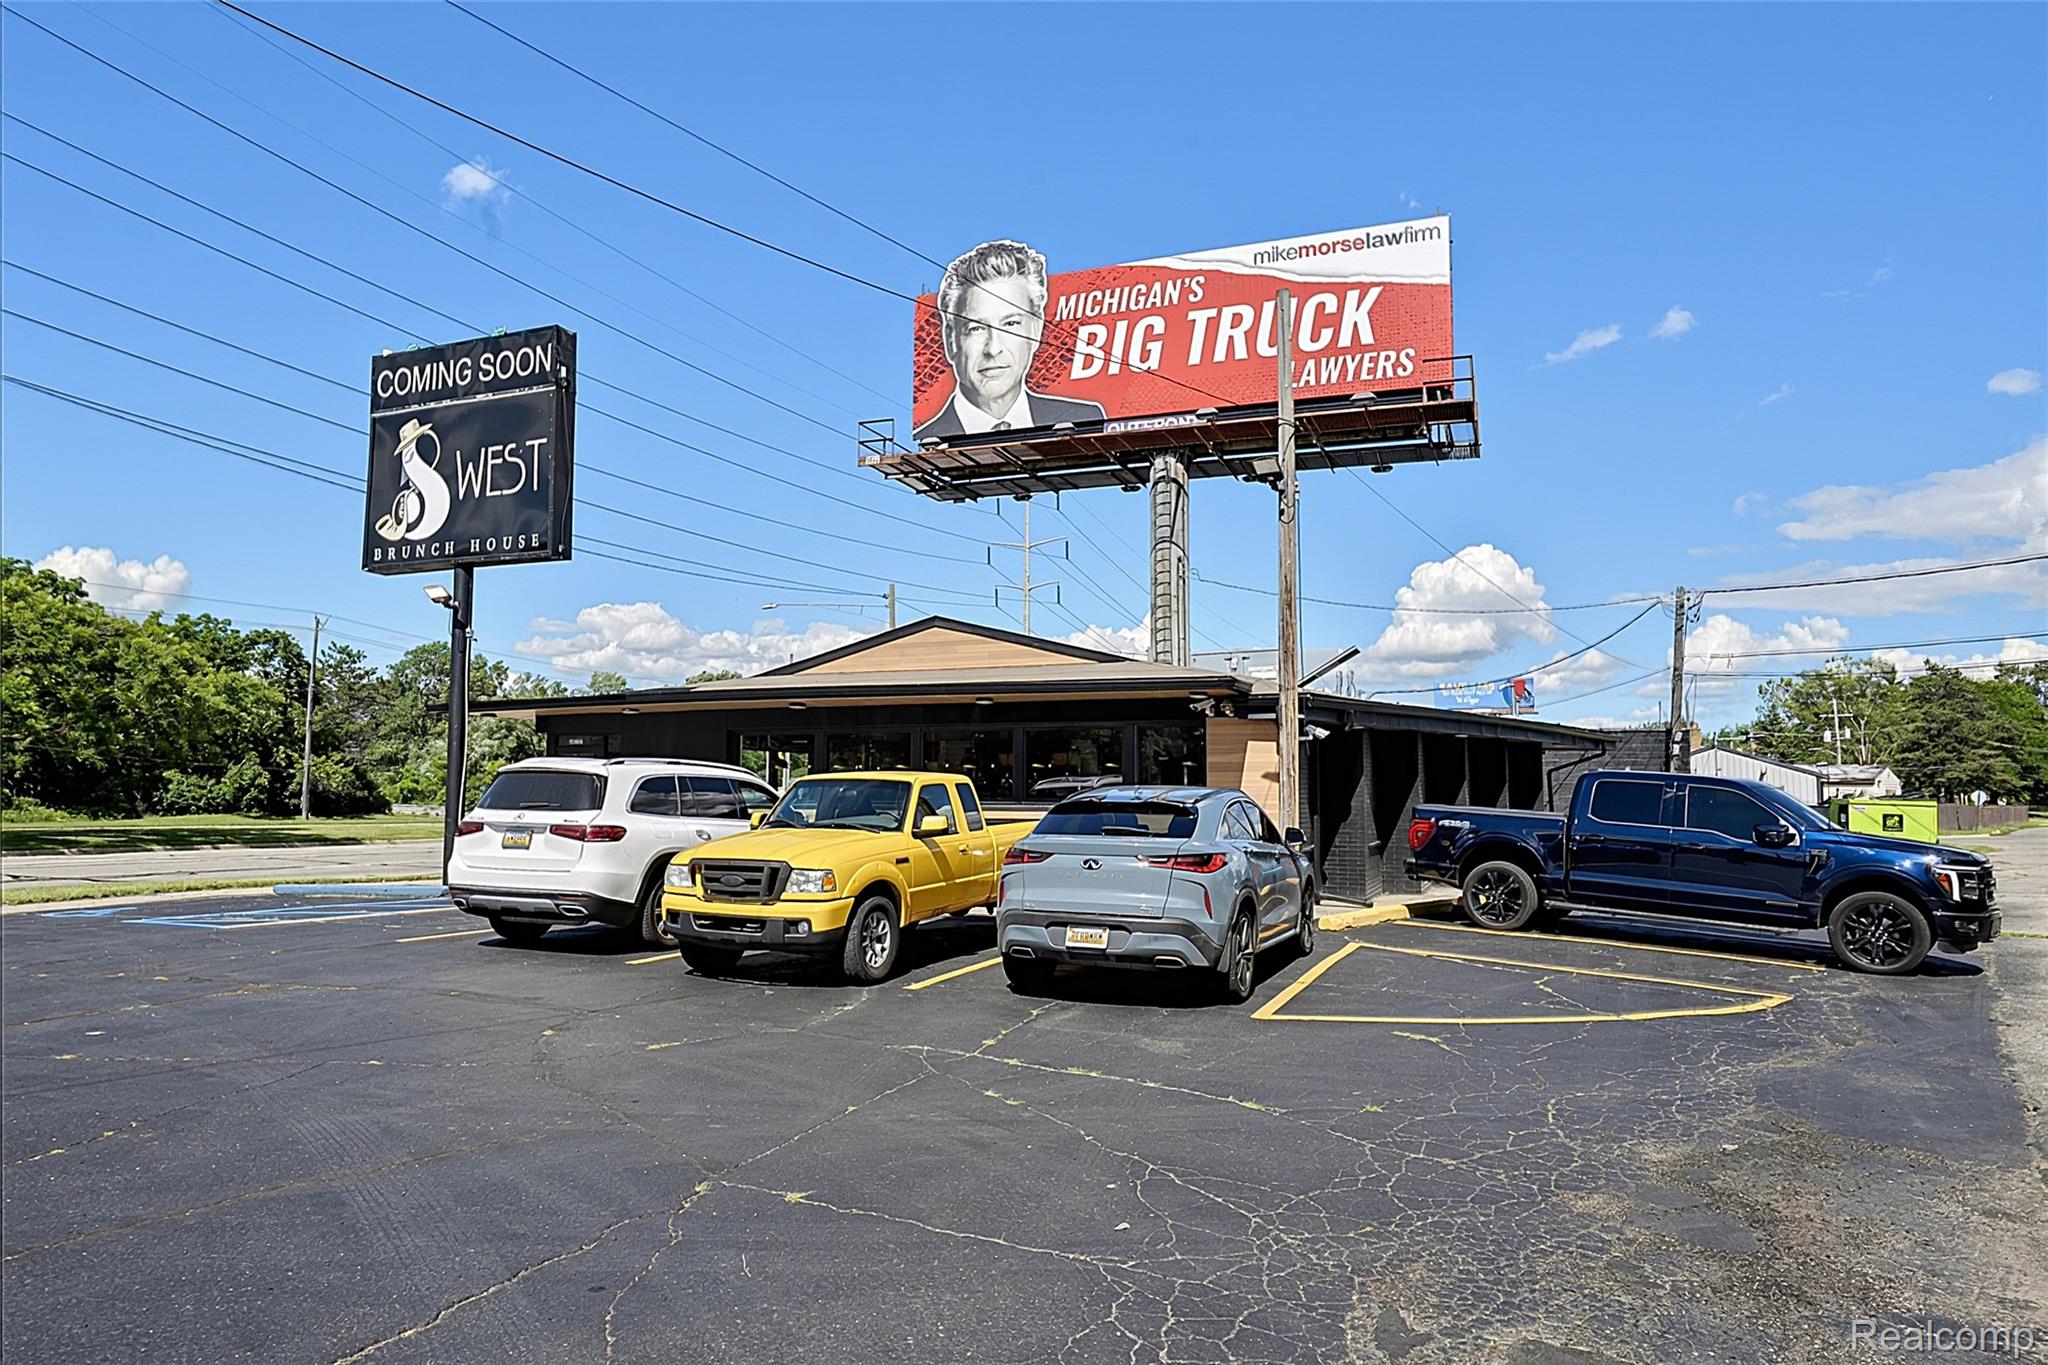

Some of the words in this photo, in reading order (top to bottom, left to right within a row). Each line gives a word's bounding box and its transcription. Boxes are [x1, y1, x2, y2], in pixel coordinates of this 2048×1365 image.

[1253, 225, 1441, 266] mikemorselawfirm
[1055, 275, 1206, 322] MICHIGAN'S
[1070, 315, 1166, 380] BIG
[1186, 286, 1384, 366] TRUCK
[376, 357, 472, 398] COMING
[478, 342, 553, 382] SOON
[456, 438, 548, 500] WEST
[374, 541, 456, 561] BRUNCH
[470, 533, 540, 553] HOUSE
